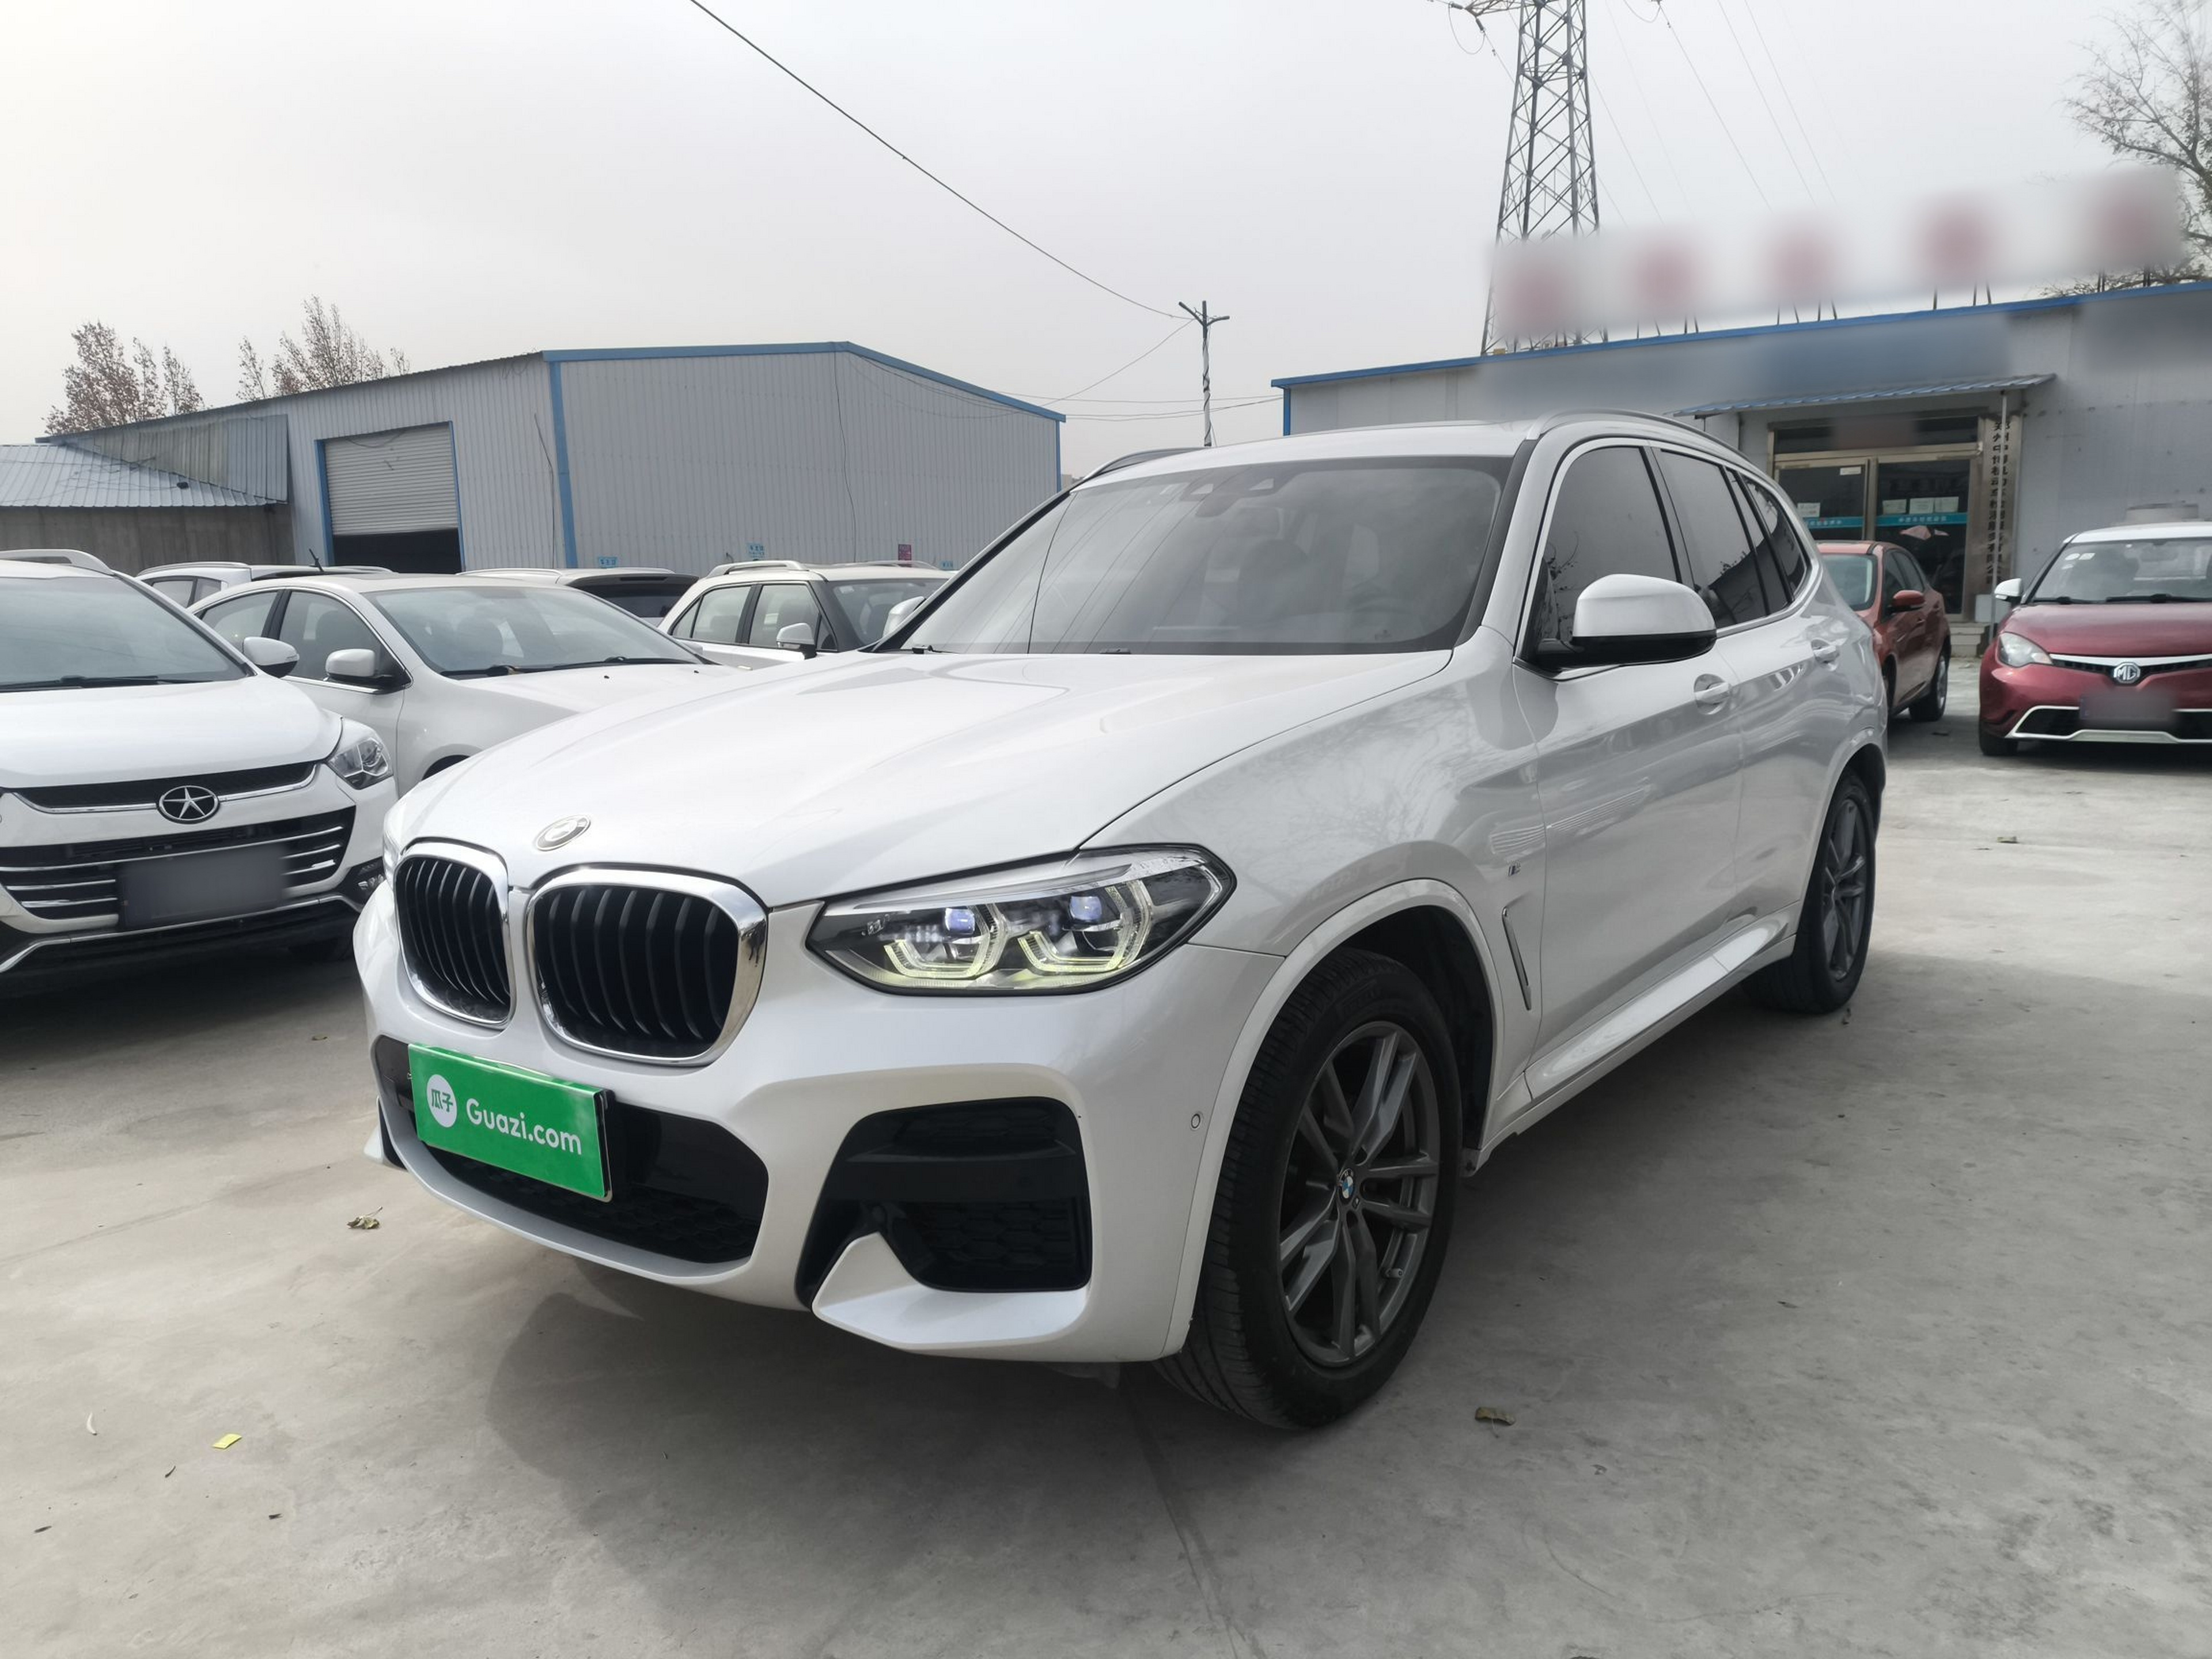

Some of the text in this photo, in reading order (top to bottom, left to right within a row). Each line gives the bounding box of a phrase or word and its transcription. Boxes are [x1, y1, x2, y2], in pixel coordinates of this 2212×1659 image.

[2116, 665, 2137, 680] MG
[431, 1088, 454, 1113] 瓜子
[467, 1098, 581, 1155] Guazi.com
